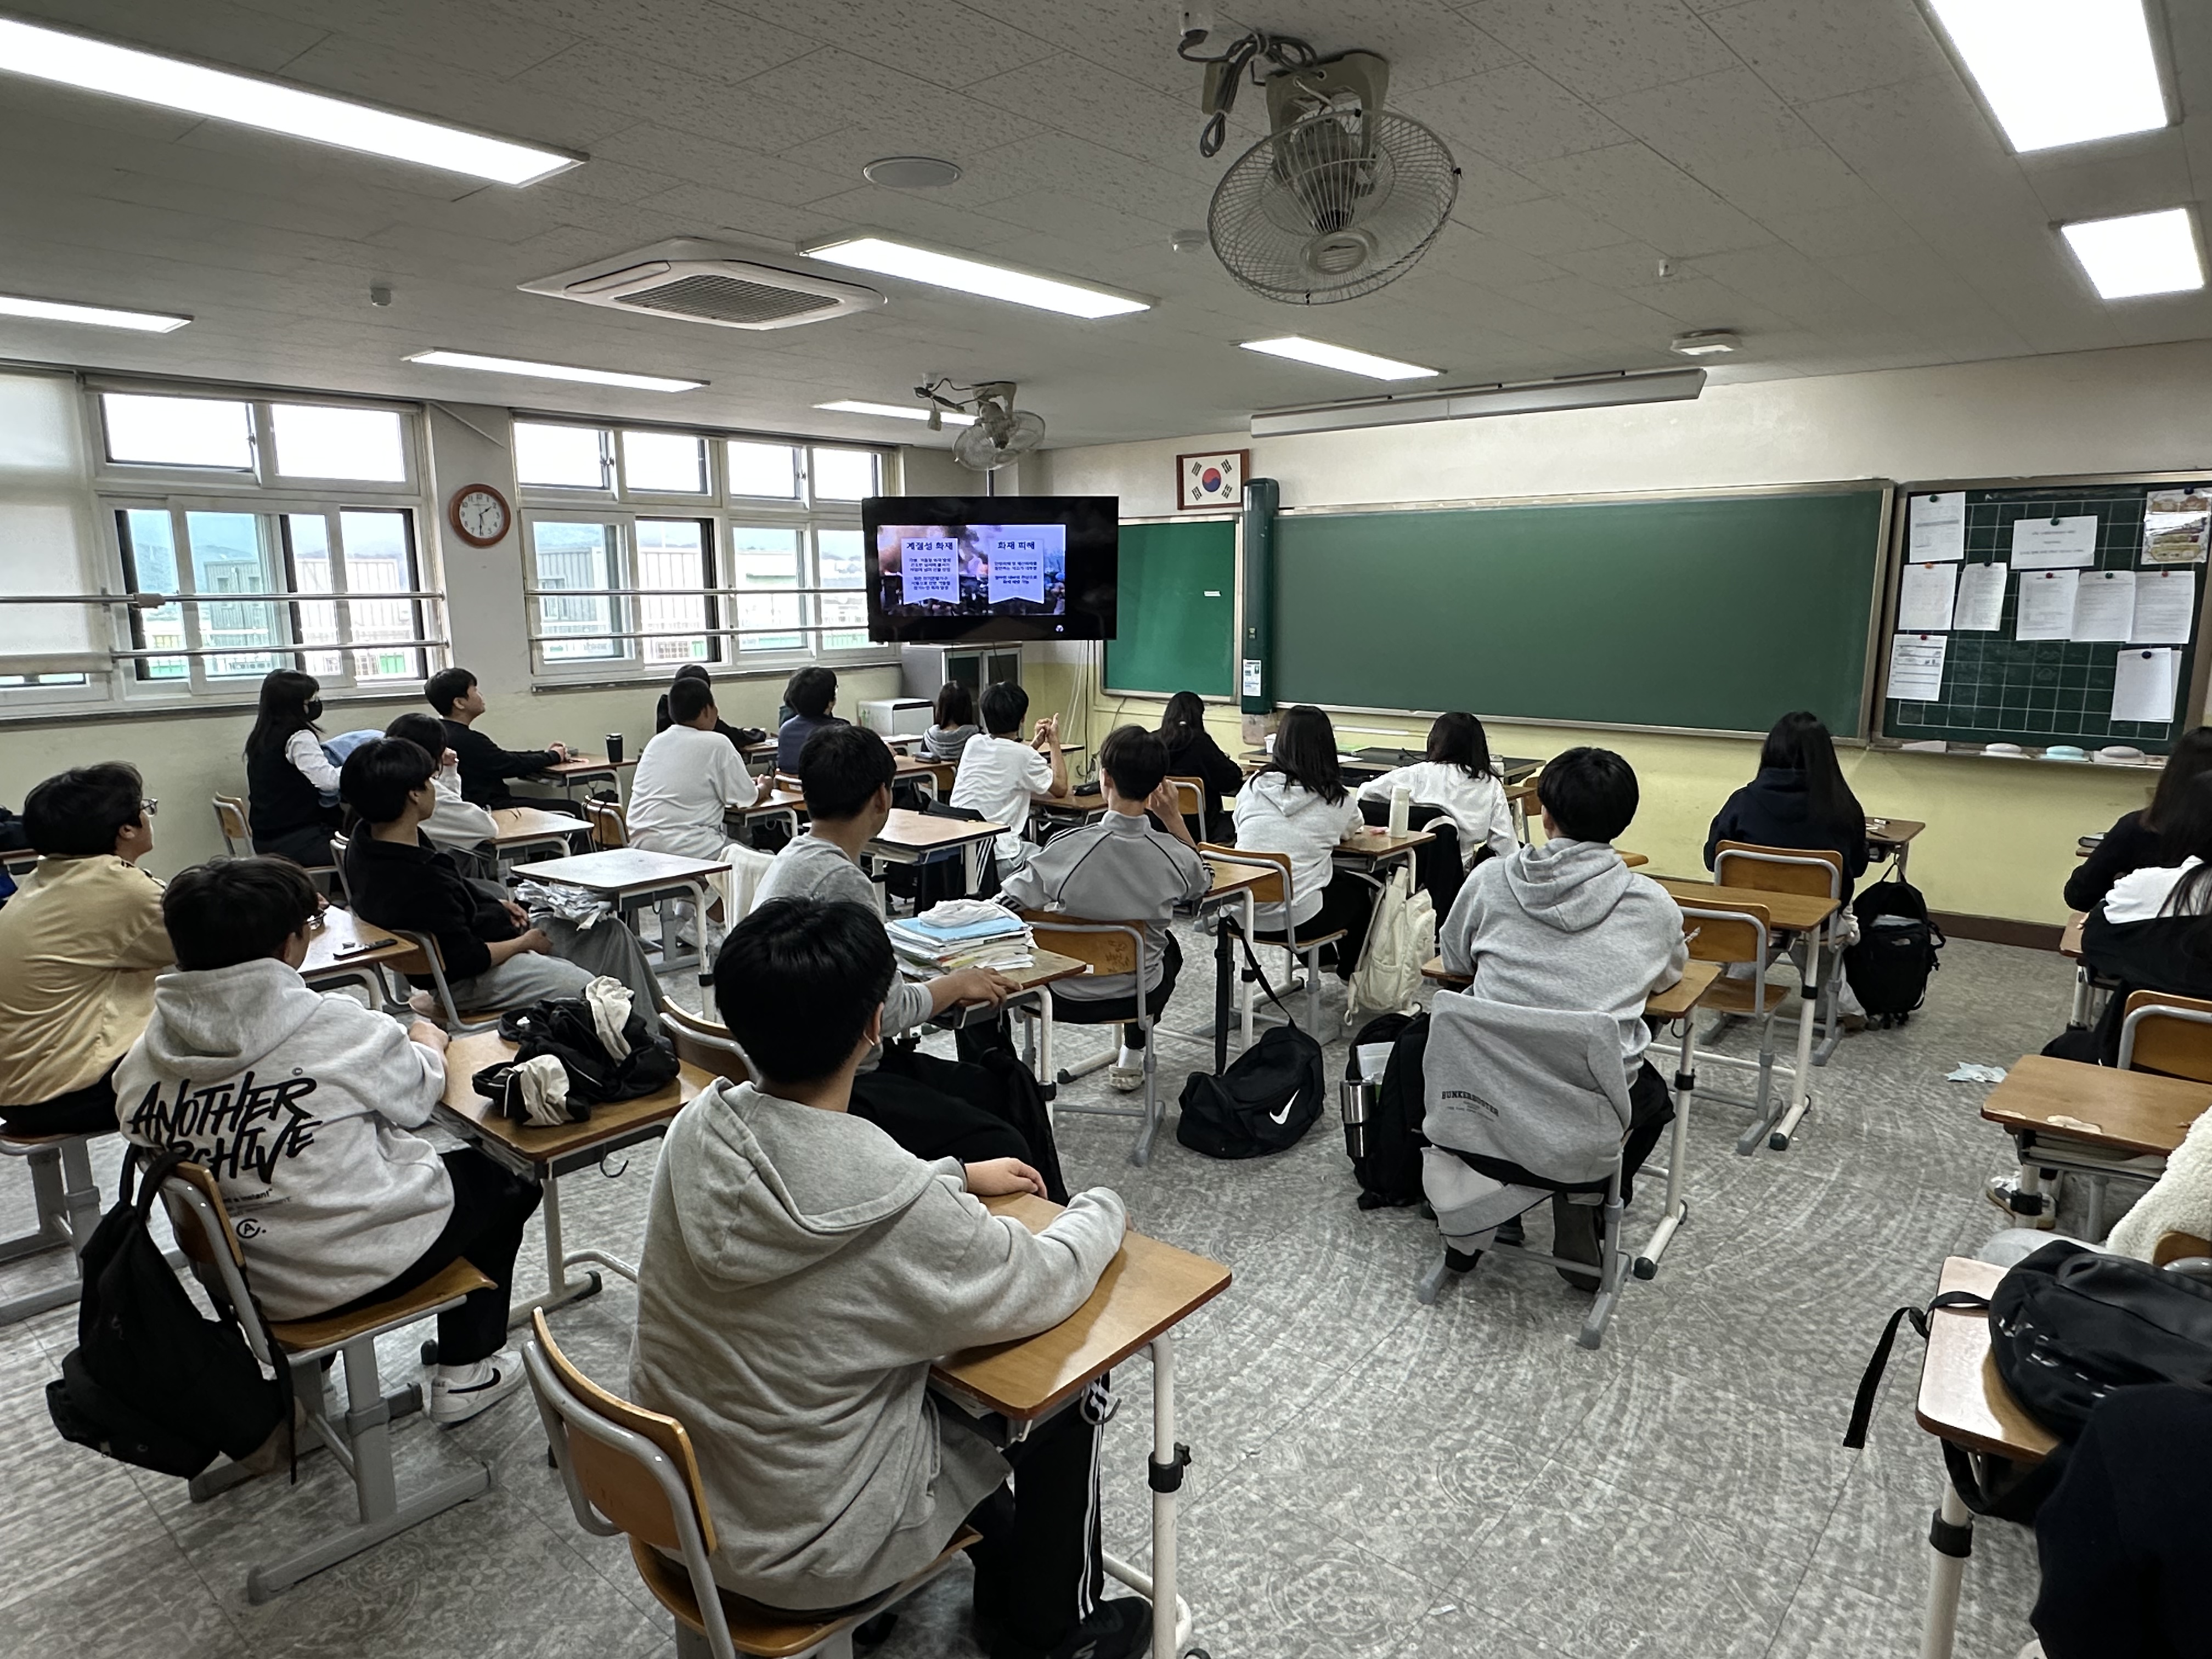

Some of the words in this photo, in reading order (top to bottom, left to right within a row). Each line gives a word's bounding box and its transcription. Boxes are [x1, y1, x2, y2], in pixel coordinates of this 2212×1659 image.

[906, 542, 933, 550] 계절성
[935, 542, 953, 550] 화재
[997, 541, 1015, 550] 화재
[1018, 541, 1035, 550] 피해
[126, 1071, 317, 1144] ANOTHER
[156, 1120, 323, 1184] RCHIVE
